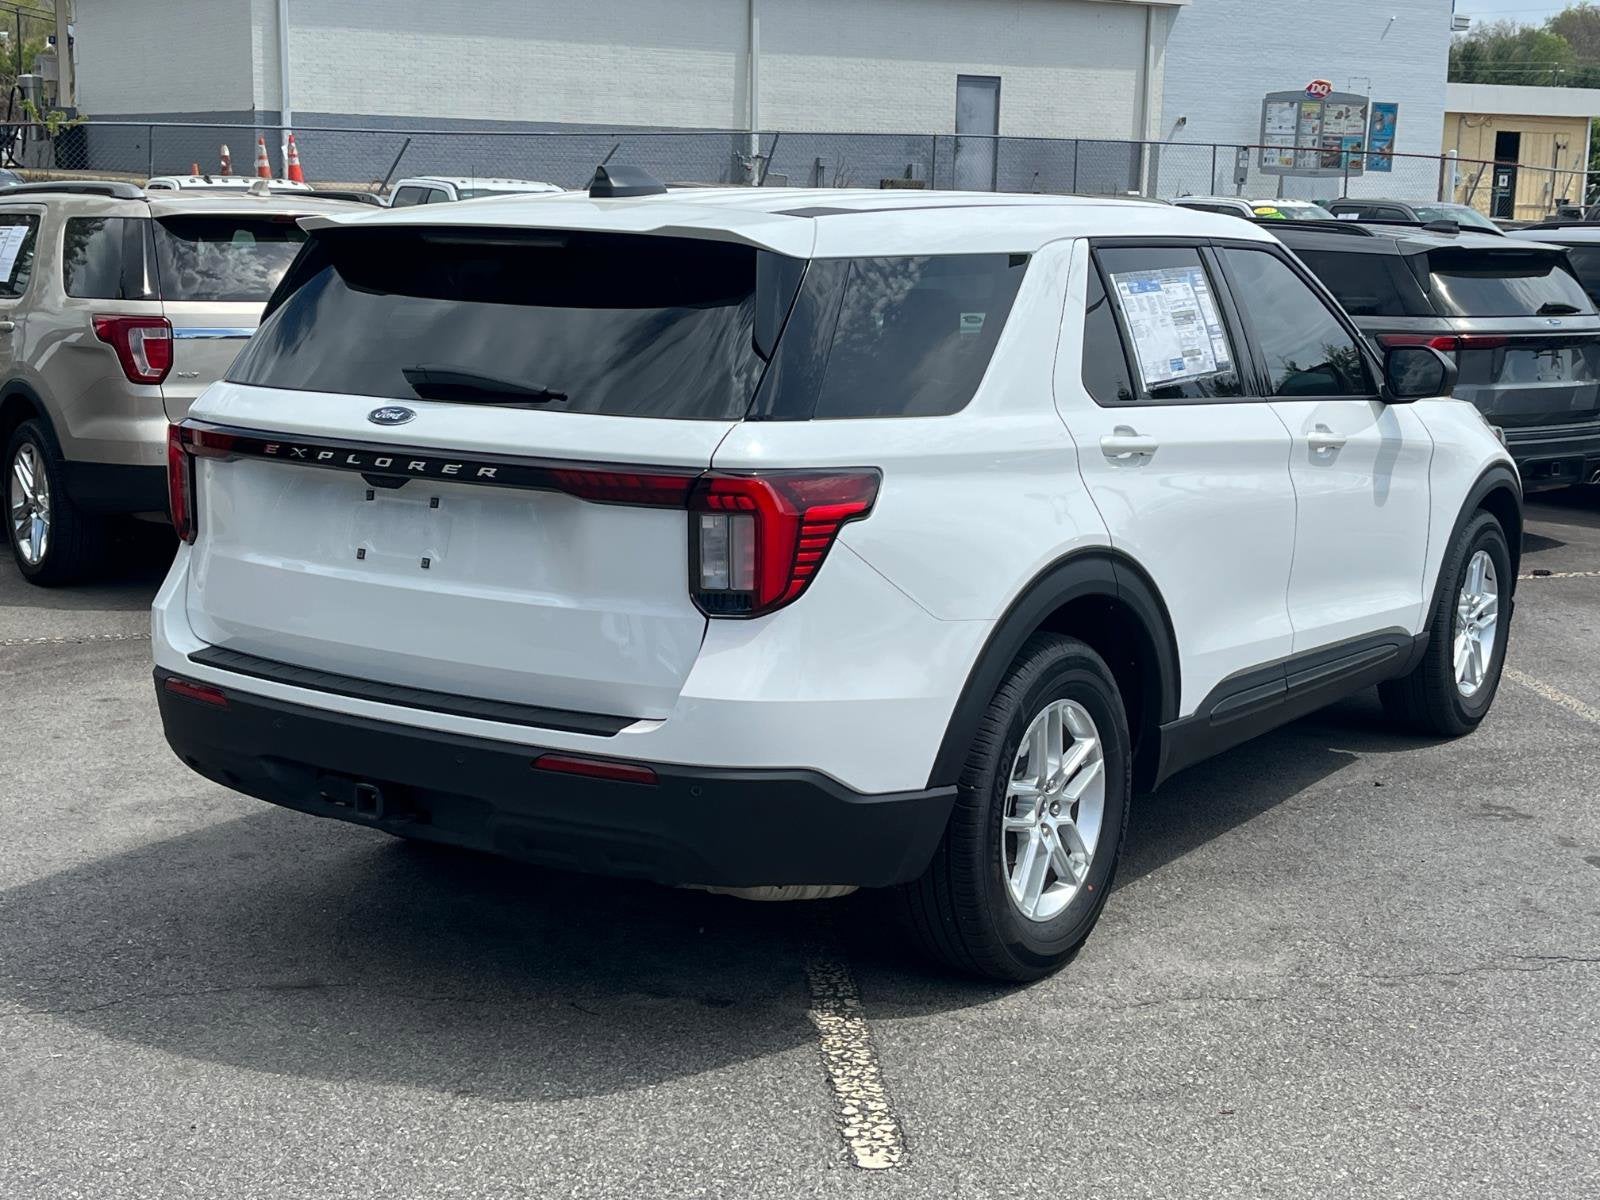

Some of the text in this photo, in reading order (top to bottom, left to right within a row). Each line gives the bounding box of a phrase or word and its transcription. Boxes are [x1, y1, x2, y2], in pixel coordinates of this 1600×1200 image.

[1309, 83, 1328, 96] DQ
[374, 408, 405, 420] Ford
[263, 443, 498, 478] EXPLORER
